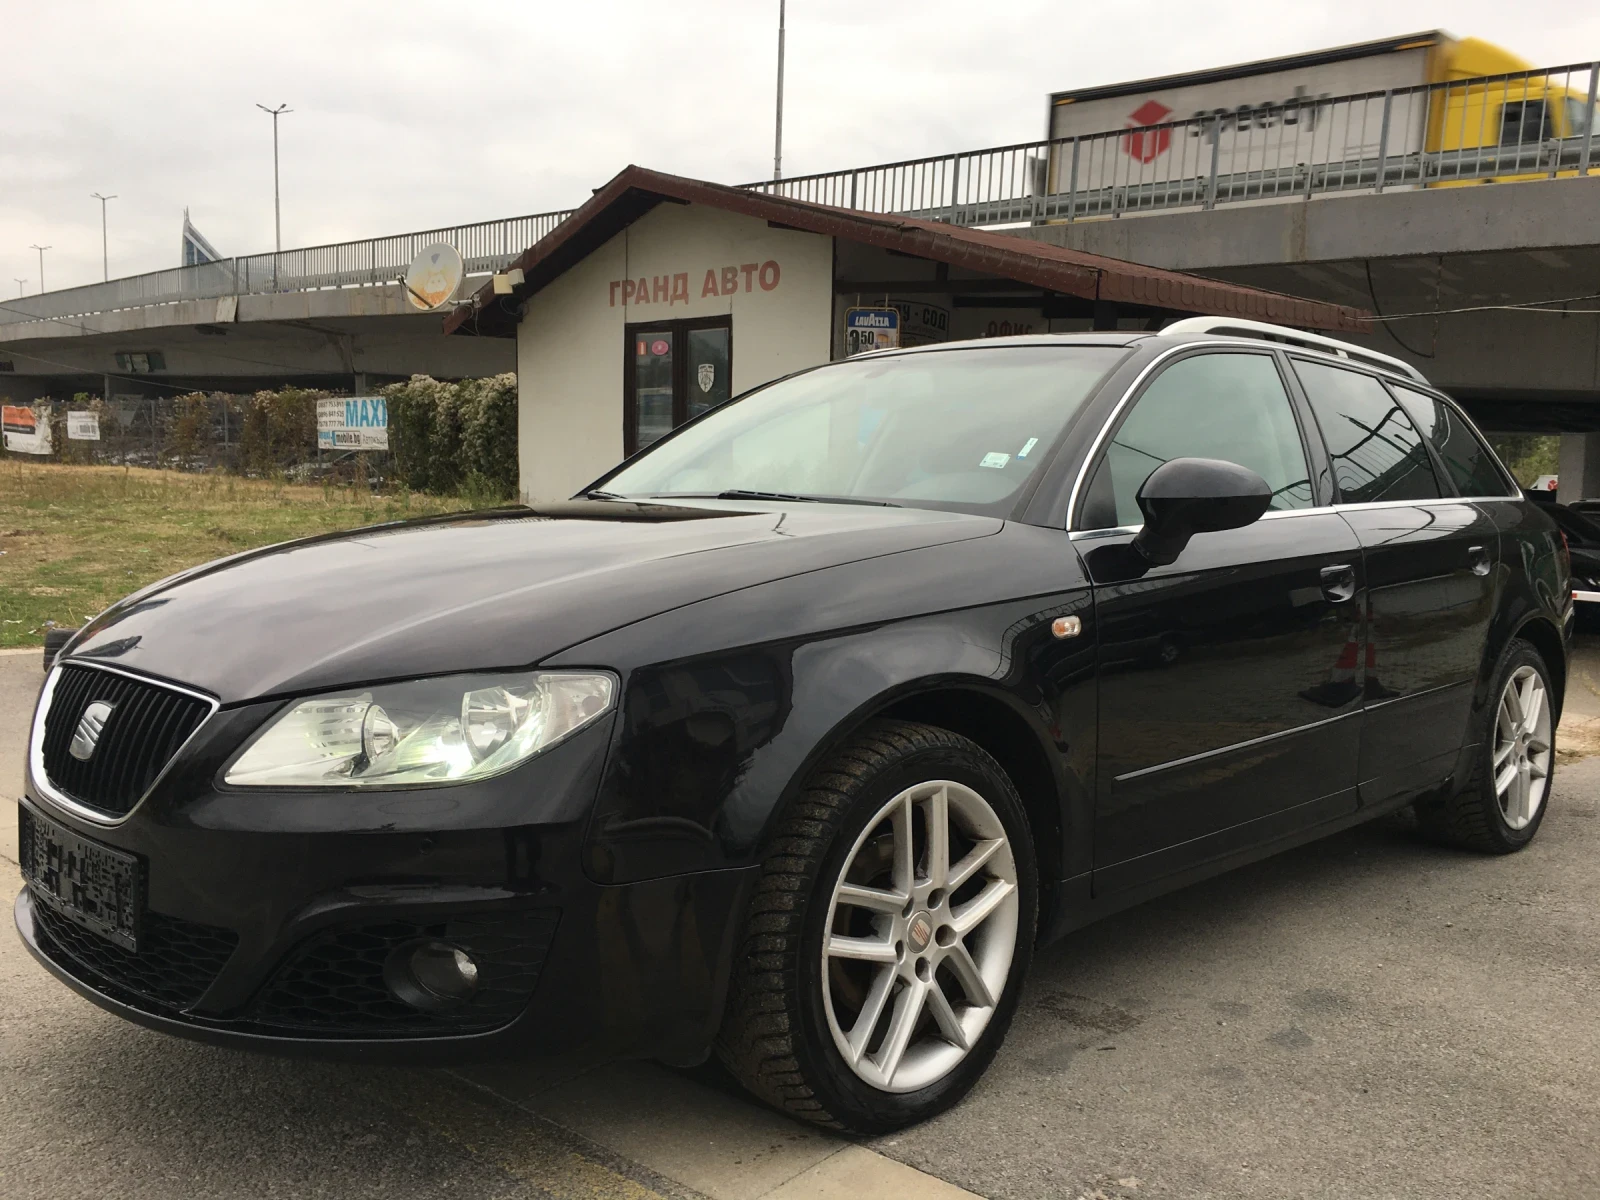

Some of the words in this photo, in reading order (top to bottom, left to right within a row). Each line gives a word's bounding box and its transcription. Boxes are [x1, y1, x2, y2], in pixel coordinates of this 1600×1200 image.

[609, 272, 689, 307] ГРАНД
[701, 260, 780, 298] АВТО
[855, 313, 889, 327] LAVAZZA
[345, 399, 387, 427] MAXI
